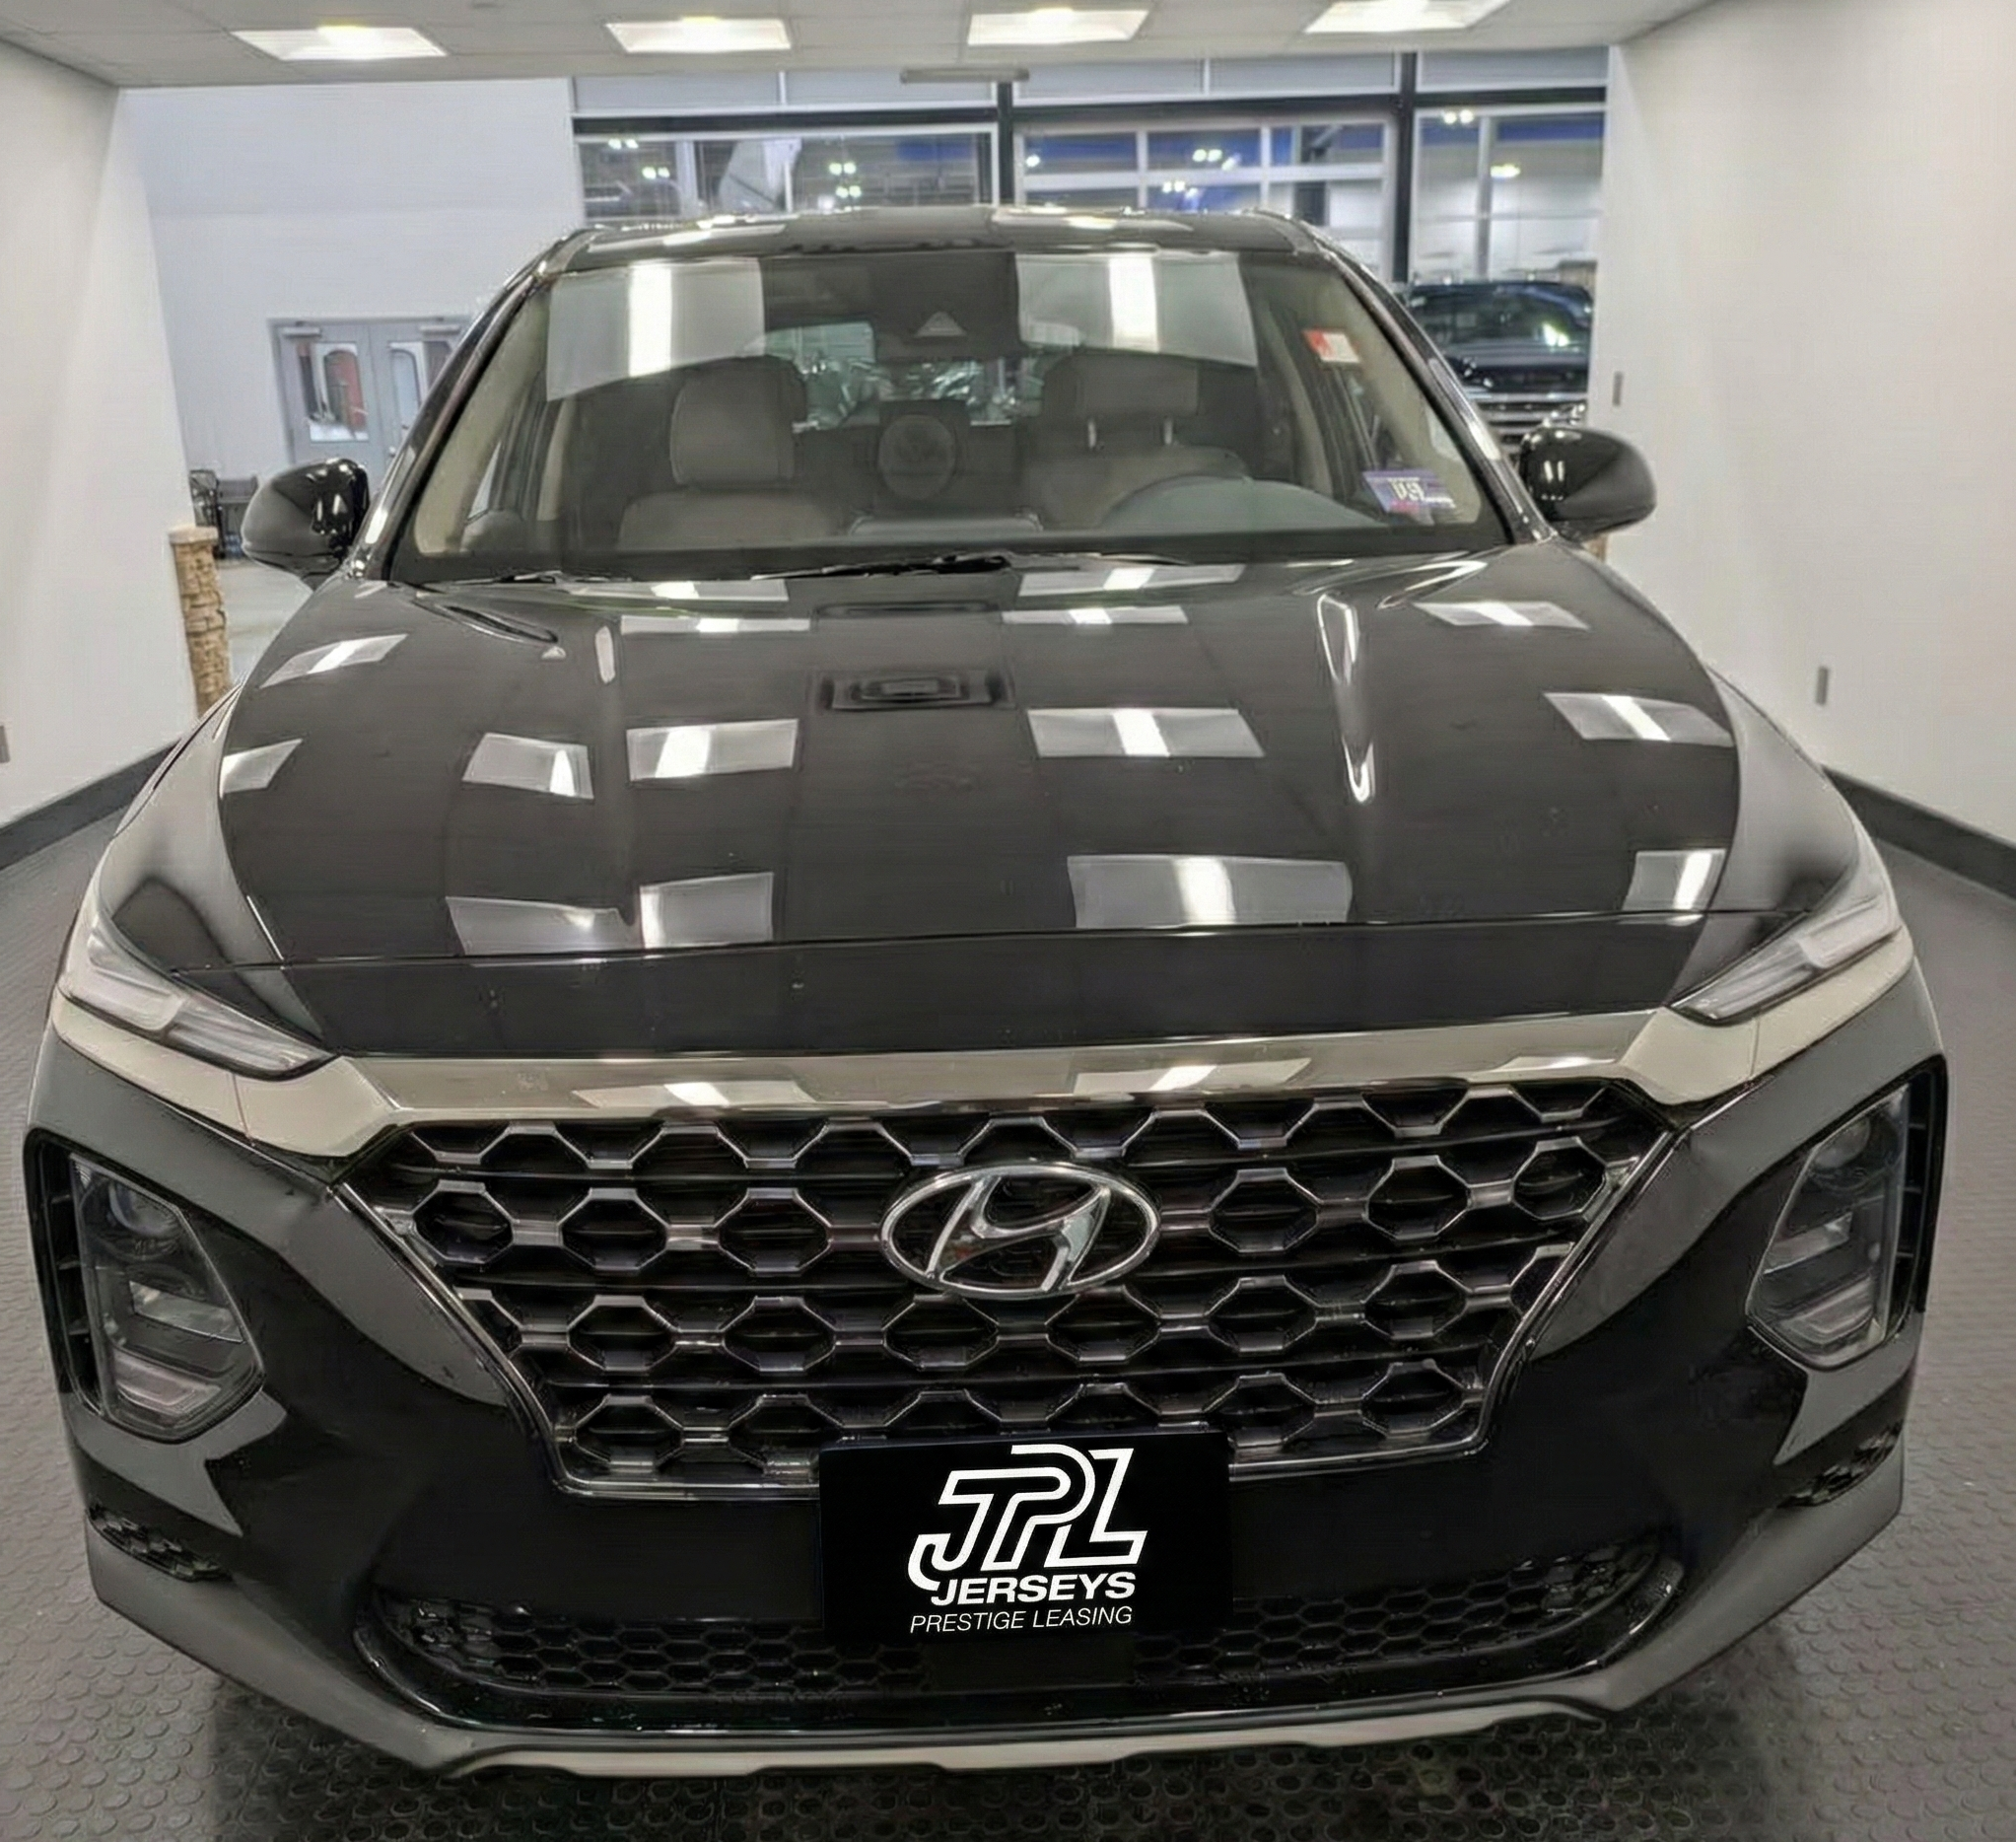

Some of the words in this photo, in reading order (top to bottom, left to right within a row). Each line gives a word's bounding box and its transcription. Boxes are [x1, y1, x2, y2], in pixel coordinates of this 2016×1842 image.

[908, 1444, 1147, 1591] JPL
[930, 1572, 1137, 1606] JERSEYS
[910, 1610, 1027, 1634] PRESTIGE
[1032, 1606, 1133, 1628] LEASING
